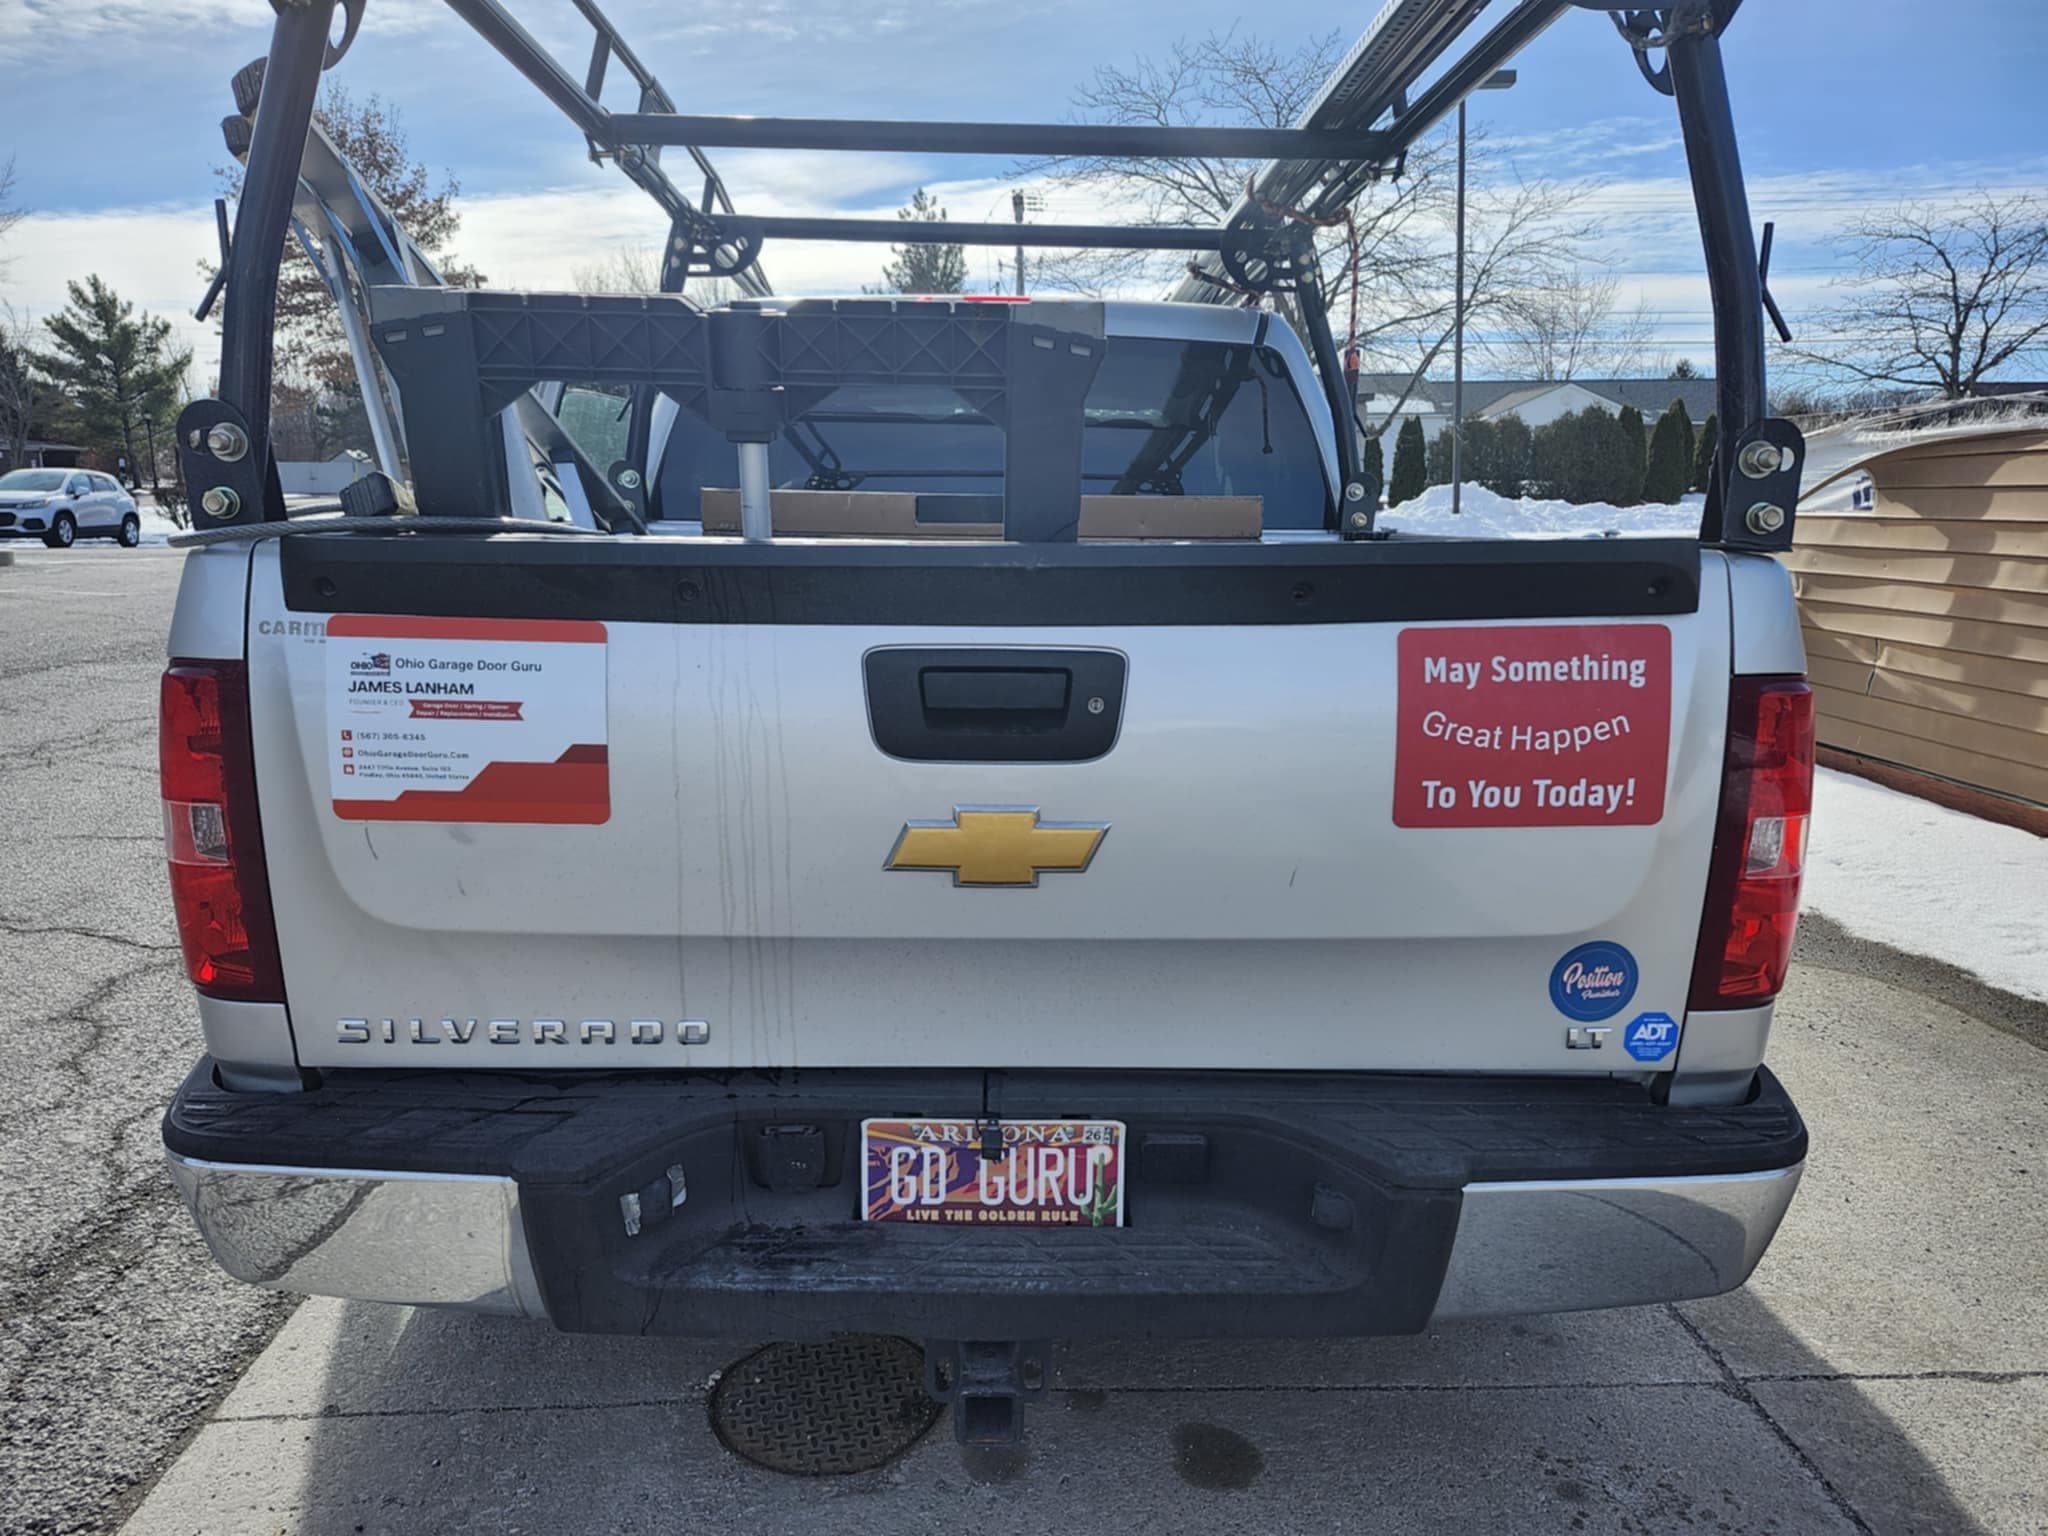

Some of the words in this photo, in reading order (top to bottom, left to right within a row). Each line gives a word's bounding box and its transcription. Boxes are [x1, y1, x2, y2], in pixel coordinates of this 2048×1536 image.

[395, 657, 425, 669] Ohio
[429, 658, 474, 673] Garage
[477, 659, 507, 671] Door
[511, 660, 542, 672] Guru
[1424, 656, 1481, 690] May
[1491, 653, 1647, 688] Something
[348, 681, 402, 694] JAMES
[405, 682, 474, 695] LANHAM
[357, 732, 380, 741] (567)
[1422, 710, 1502, 750] Great
[1510, 714, 1631, 755] Happen
[1422, 780, 1457, 809] To
[1468, 779, 1521, 808] You
[1532, 777, 1636, 814] Today!
[1562, 962, 1625, 993] Position
[335, 1017, 711, 1045] SILVERADO
[1566, 1027, 1612, 1049] LT
[1632, 1023, 1673, 1040] ADT
[917, 1125, 1070, 1143] ARIONA
[1085, 1128, 1102, 1141] 26
[891, 1146, 946, 1206] GD
[979, 1147, 1096, 1207] GURU
[907, 1209, 940, 1221] LIVE
[945, 1210, 974, 1221] THE
[978, 1210, 1036, 1221] GOLDEN
[1041, 1210, 1079, 1222] RULE
